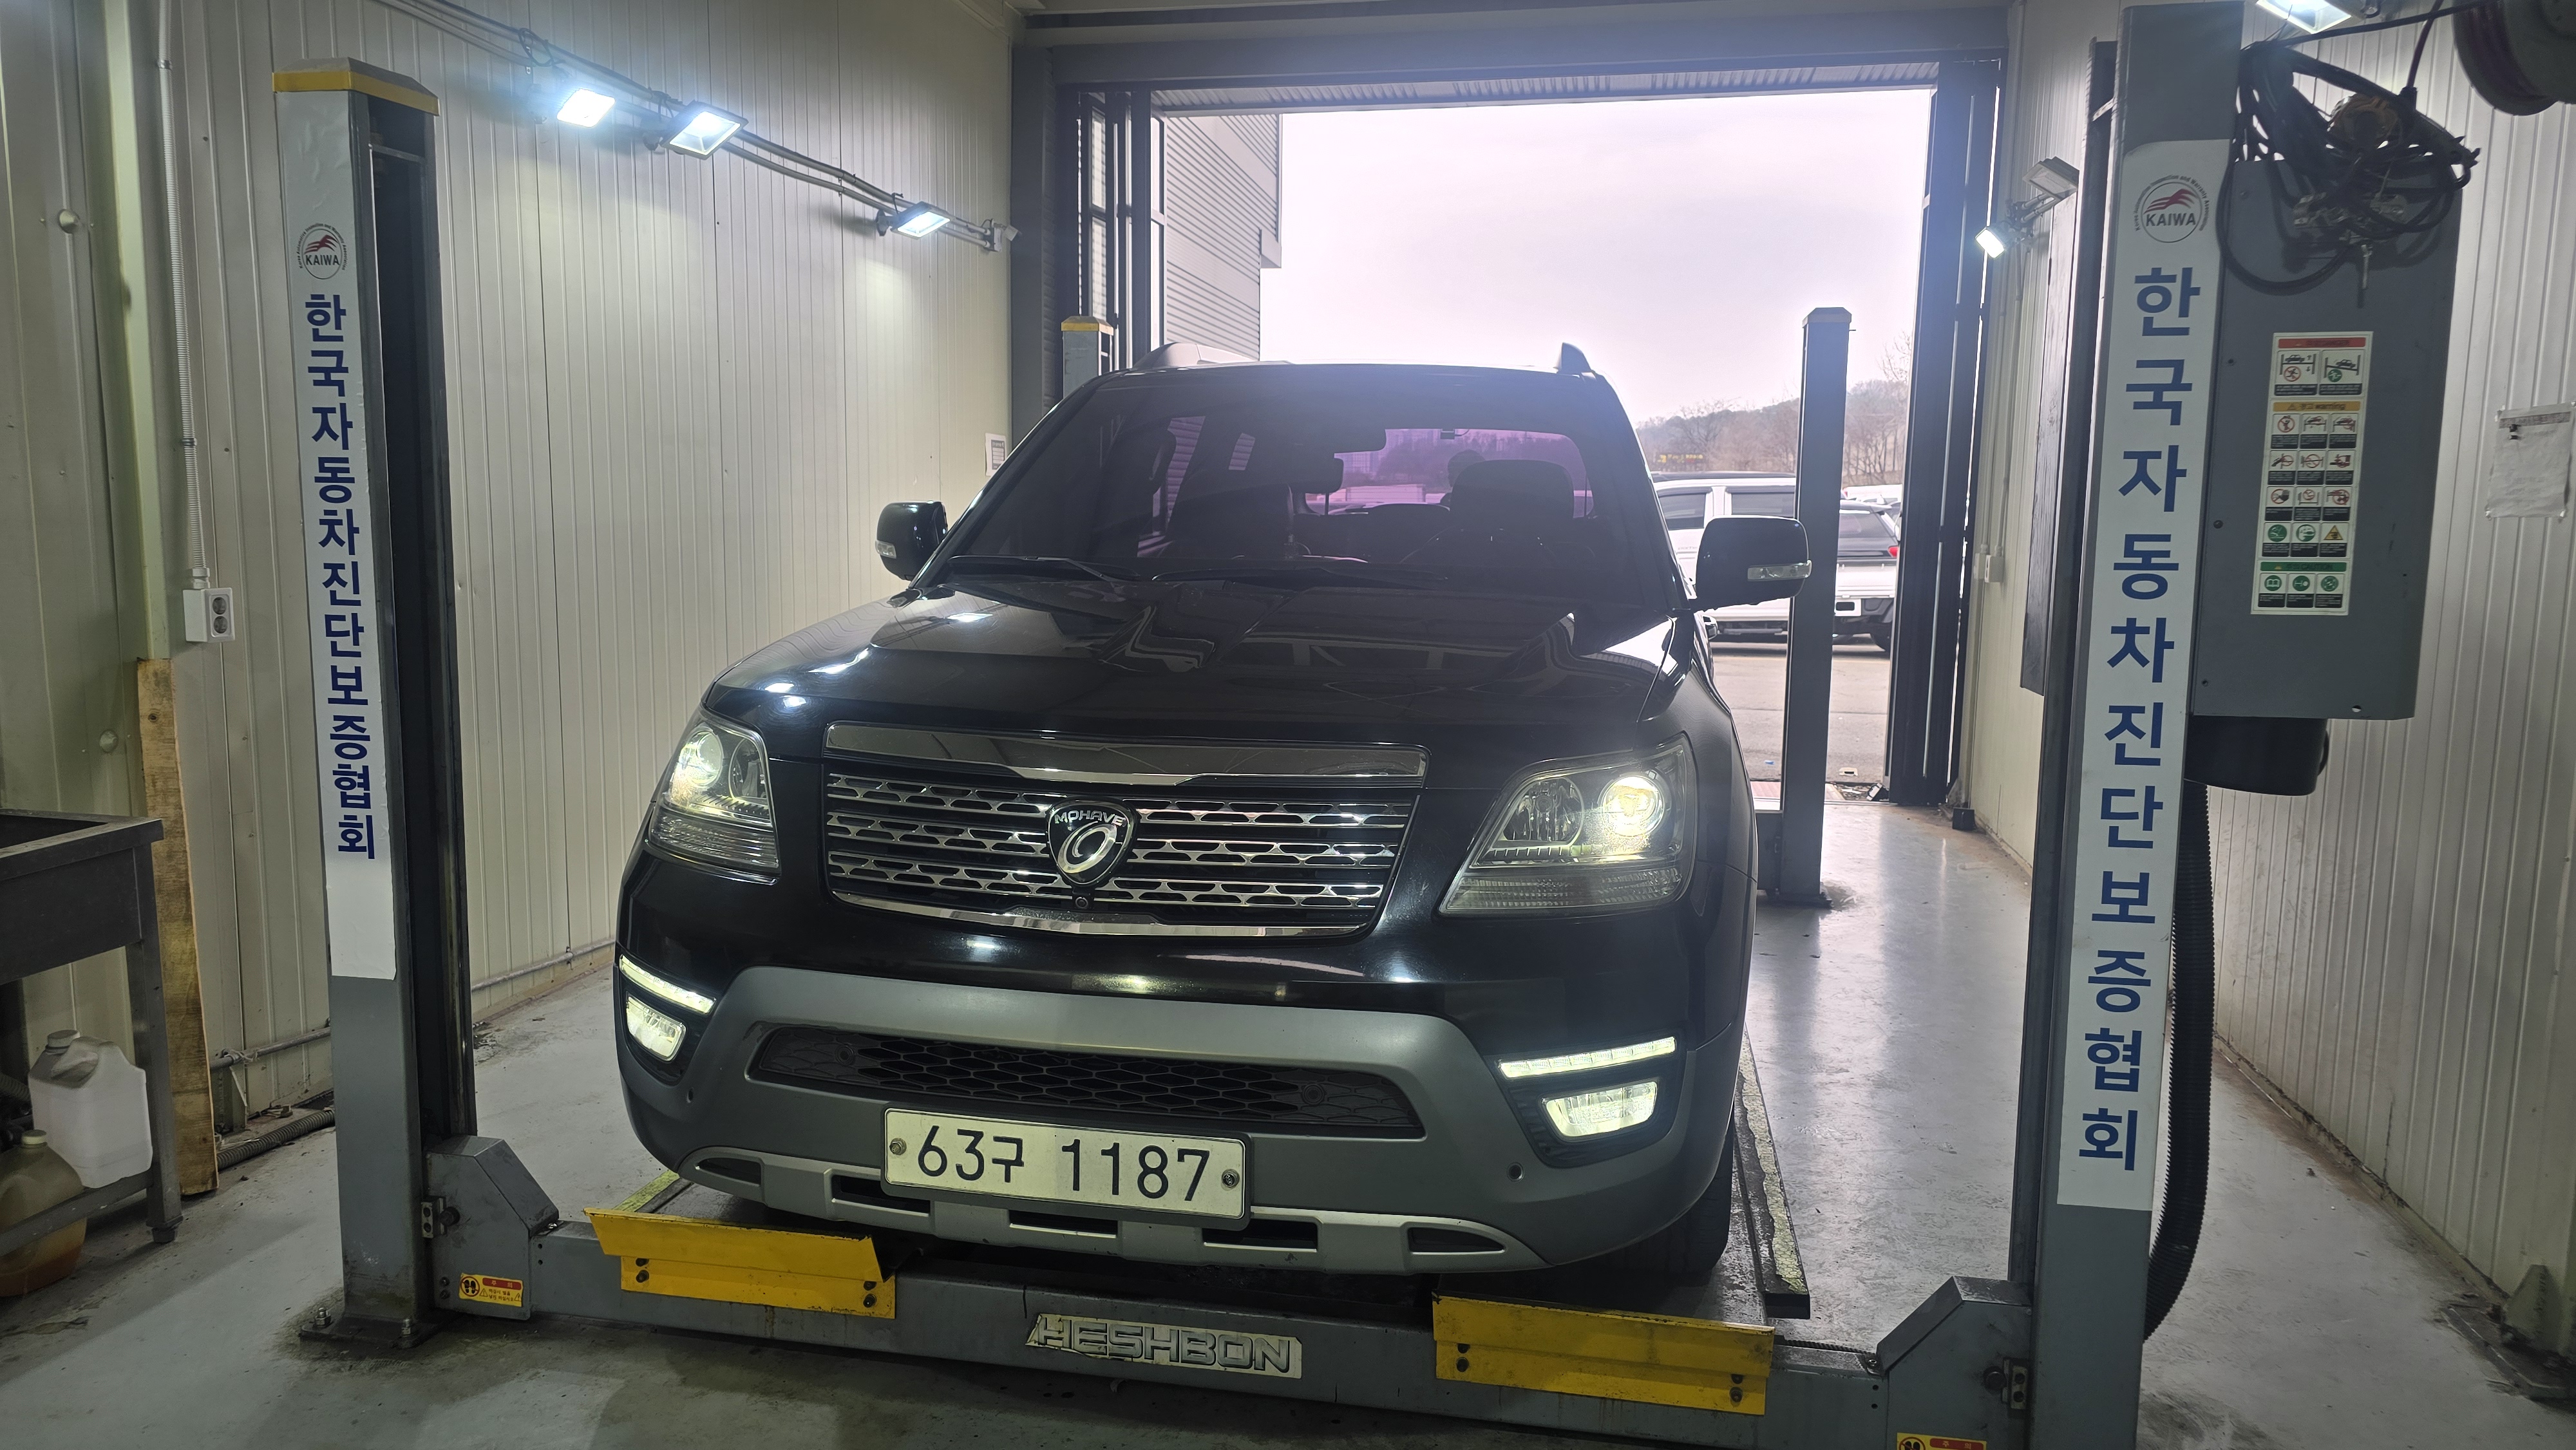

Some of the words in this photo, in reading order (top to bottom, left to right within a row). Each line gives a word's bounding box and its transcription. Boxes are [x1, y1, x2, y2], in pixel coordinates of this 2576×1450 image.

[2146, 212, 2196, 227] KAIWA
[305, 254, 340, 266] KAIWA
[305, 294, 375, 860] 한국자동차진단보증협회
[2079, 267, 2201, 1171] 한국자동차진단보증협회
[1054, 810, 1126, 827] MOHAVE
[917, 1125, 1025, 1183] 63구
[1061, 1139, 1210, 1201] 1187
[1037, 1317, 1291, 1373] HESHBON
